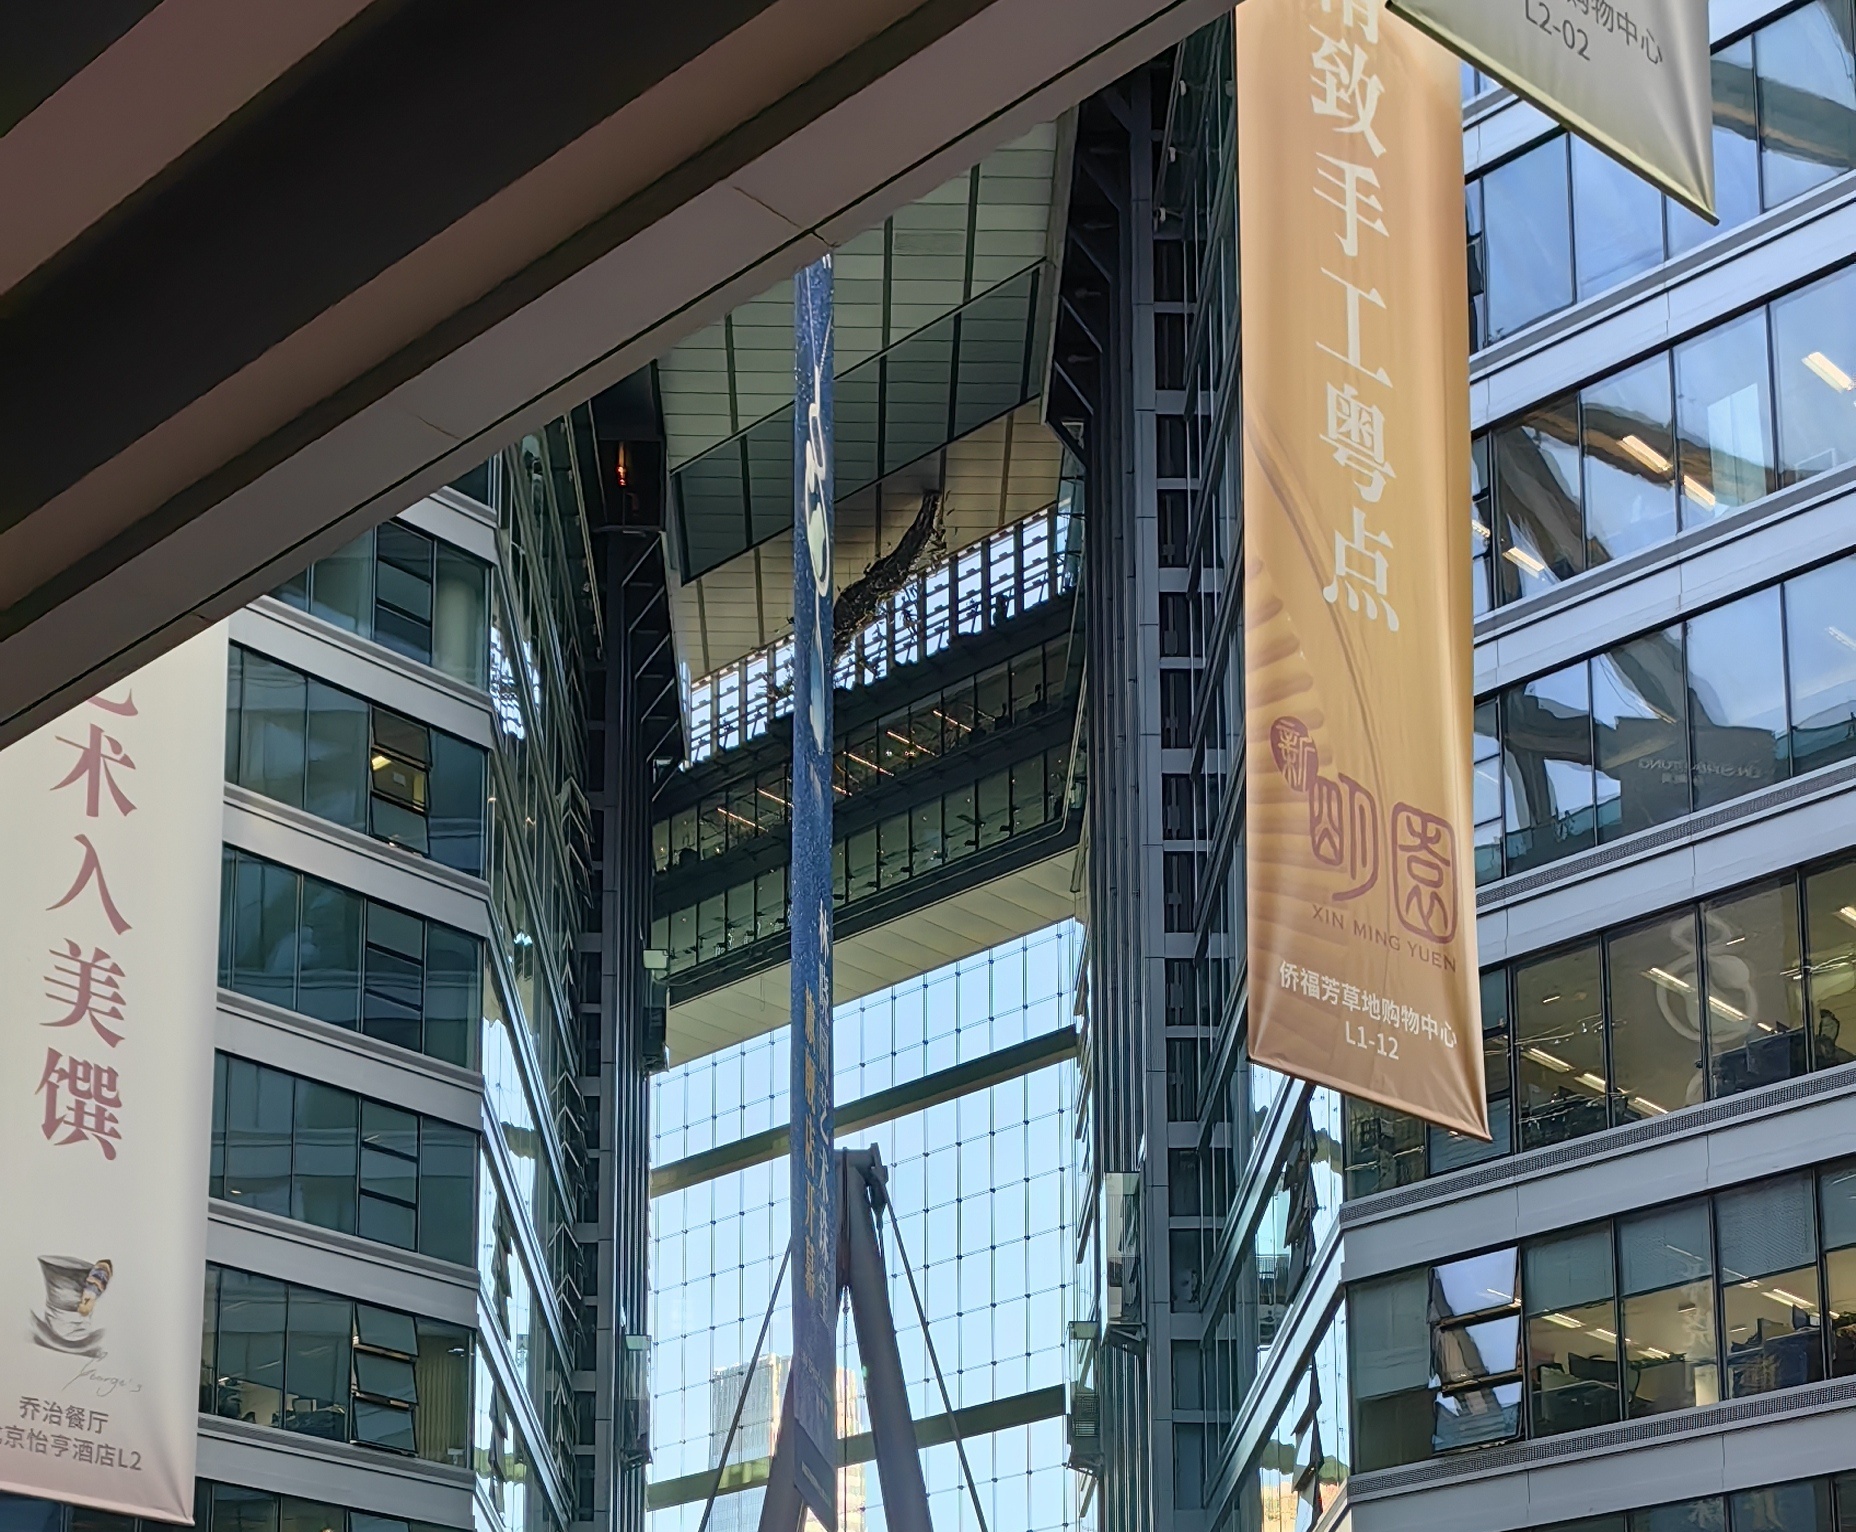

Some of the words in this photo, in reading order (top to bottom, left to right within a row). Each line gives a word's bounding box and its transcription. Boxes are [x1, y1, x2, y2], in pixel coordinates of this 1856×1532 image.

[1525, 0, 1590, 61] L2-02
[1312, 904, 1345, 930] XIN
[1353, 919, 1401, 951] MING
[1407, 940, 1457, 973] YUEN
[1279, 960, 1458, 1048] 侨福芳草地购物中心
[1345, 1020, 1400, 1060] L1-12
[19, 1395, 109, 1435] 乔治餐厅
[0, 1424, 143, 1471] 京怡亨酒店L2
